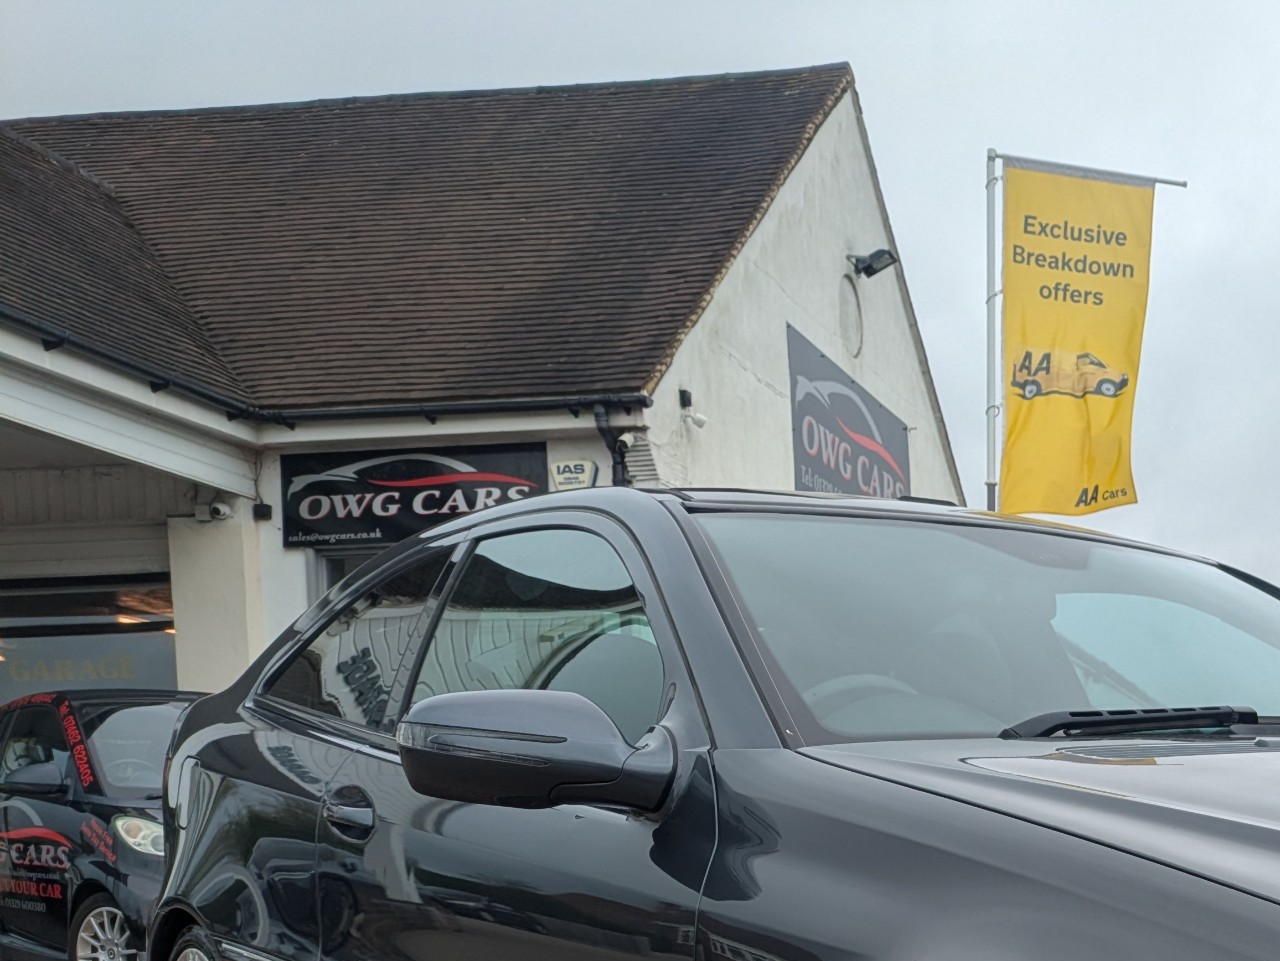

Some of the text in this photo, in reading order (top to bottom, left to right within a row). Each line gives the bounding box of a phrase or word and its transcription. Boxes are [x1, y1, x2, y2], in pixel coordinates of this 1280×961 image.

[1023, 214, 1128, 246] Exclusive
[1012, 244, 1135, 278] Breakdown
[1039, 281, 1104, 306] offers
[1018, 350, 1051, 377] AA
[556, 463, 585, 475] IAS
[801, 414, 905, 499] OWG CARS
[801, 464, 813, 489] Tel:
[298, 485, 531, 521] OWG CARS
[1074, 484, 1099, 508] AA
[288, 528, 383, 544] sales@owgcars.co.uk
[9, 655, 137, 682] GARAGE
[73, 745, 94, 787] 622405
[39, 882, 63, 899] CAR
